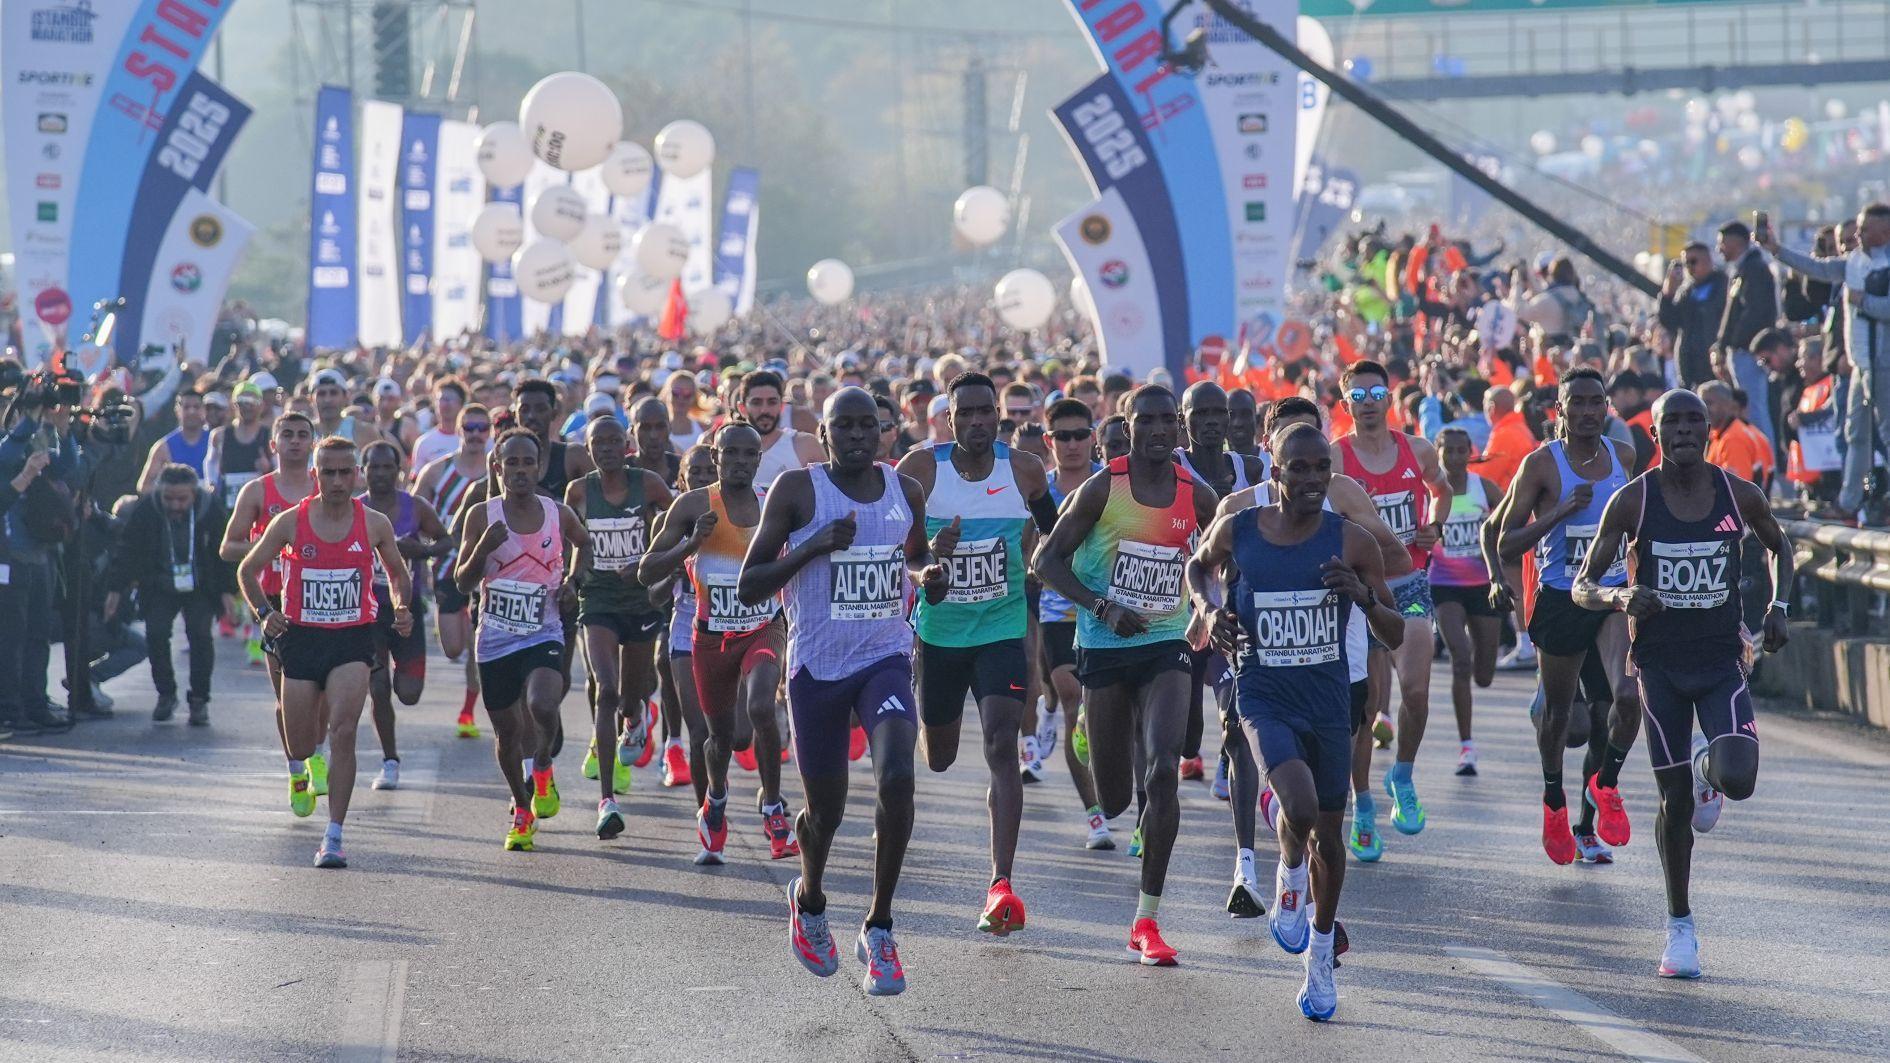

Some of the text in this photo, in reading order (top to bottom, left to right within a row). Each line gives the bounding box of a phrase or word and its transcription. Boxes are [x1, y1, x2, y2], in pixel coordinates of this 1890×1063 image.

[157, 91, 231, 181] 2025
[1072, 93, 1148, 180] 2025
[1407, 494, 1415, 502] 19
[1443, 521, 1481, 546] ROMA
[999, 542, 1005, 551] 1
[1719, 546, 1730, 555] 94
[894, 549, 904, 559] 92
[939, 552, 1005, 588] DEJENE
[1113, 555, 1183, 595] CHRISTOPHER
[1657, 557, 1727, 592] BOAZ
[355, 572, 361, 580] 5
[833, 561, 903, 601] ALFONCE
[538, 588, 547, 596] 23
[1689, 592, 1725, 601] MARATHON
[1326, 594, 1338, 604] 93
[488, 589, 542, 624] FETENE
[1257, 605, 1338, 648] OBADIAH
[1297, 645, 1334, 656] MARATHON
[1321, 652, 1336, 661] 2025
